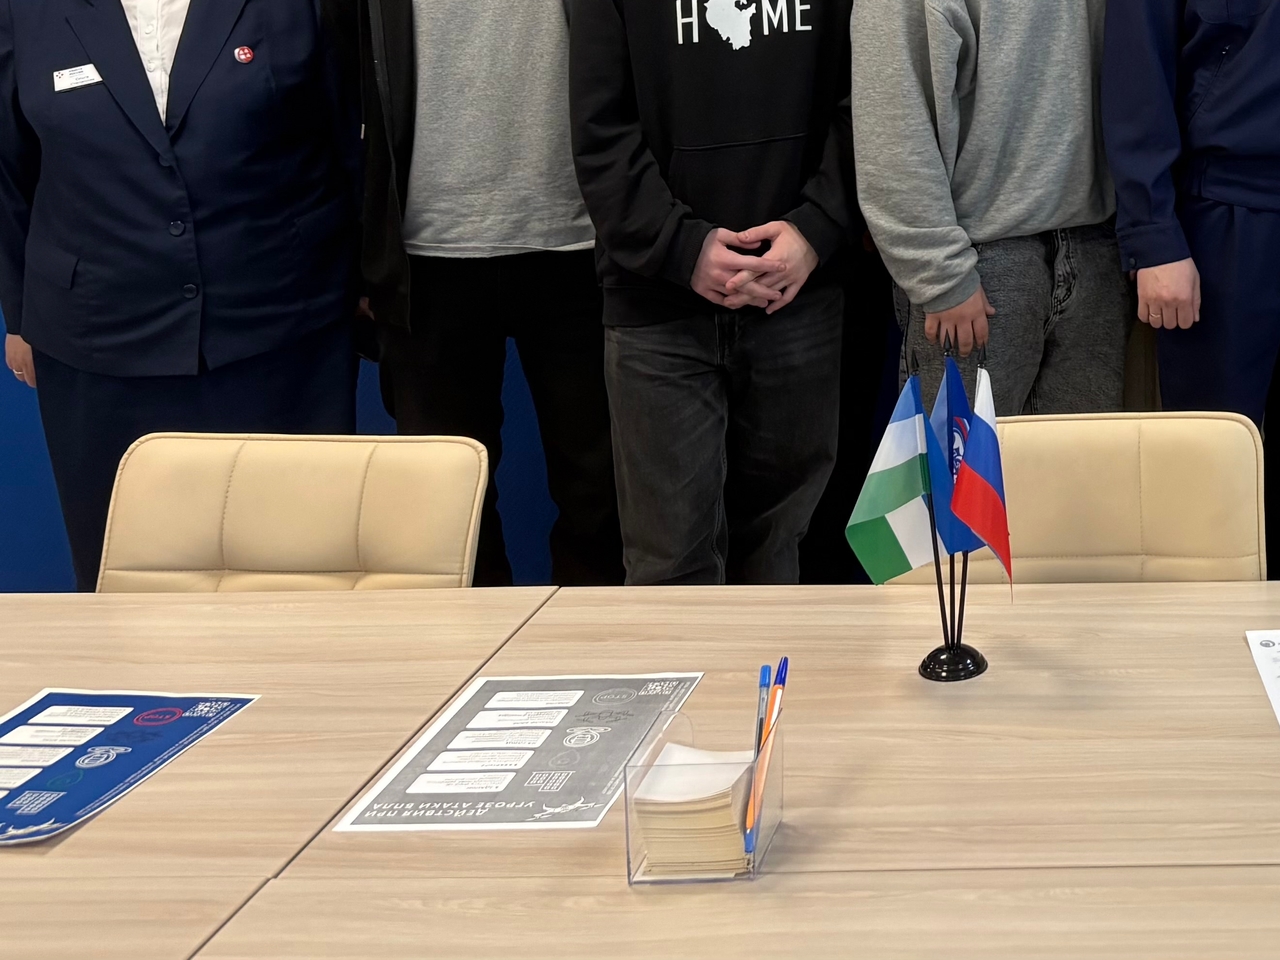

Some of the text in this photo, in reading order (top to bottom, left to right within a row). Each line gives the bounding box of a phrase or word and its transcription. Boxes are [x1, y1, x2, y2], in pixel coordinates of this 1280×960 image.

[420, 802, 473, 810] АТАКИ
[475, 801, 536, 809] УГРОЗЕ
[364, 808, 489, 818] ДЕЙСТВИЯ ПРИ
